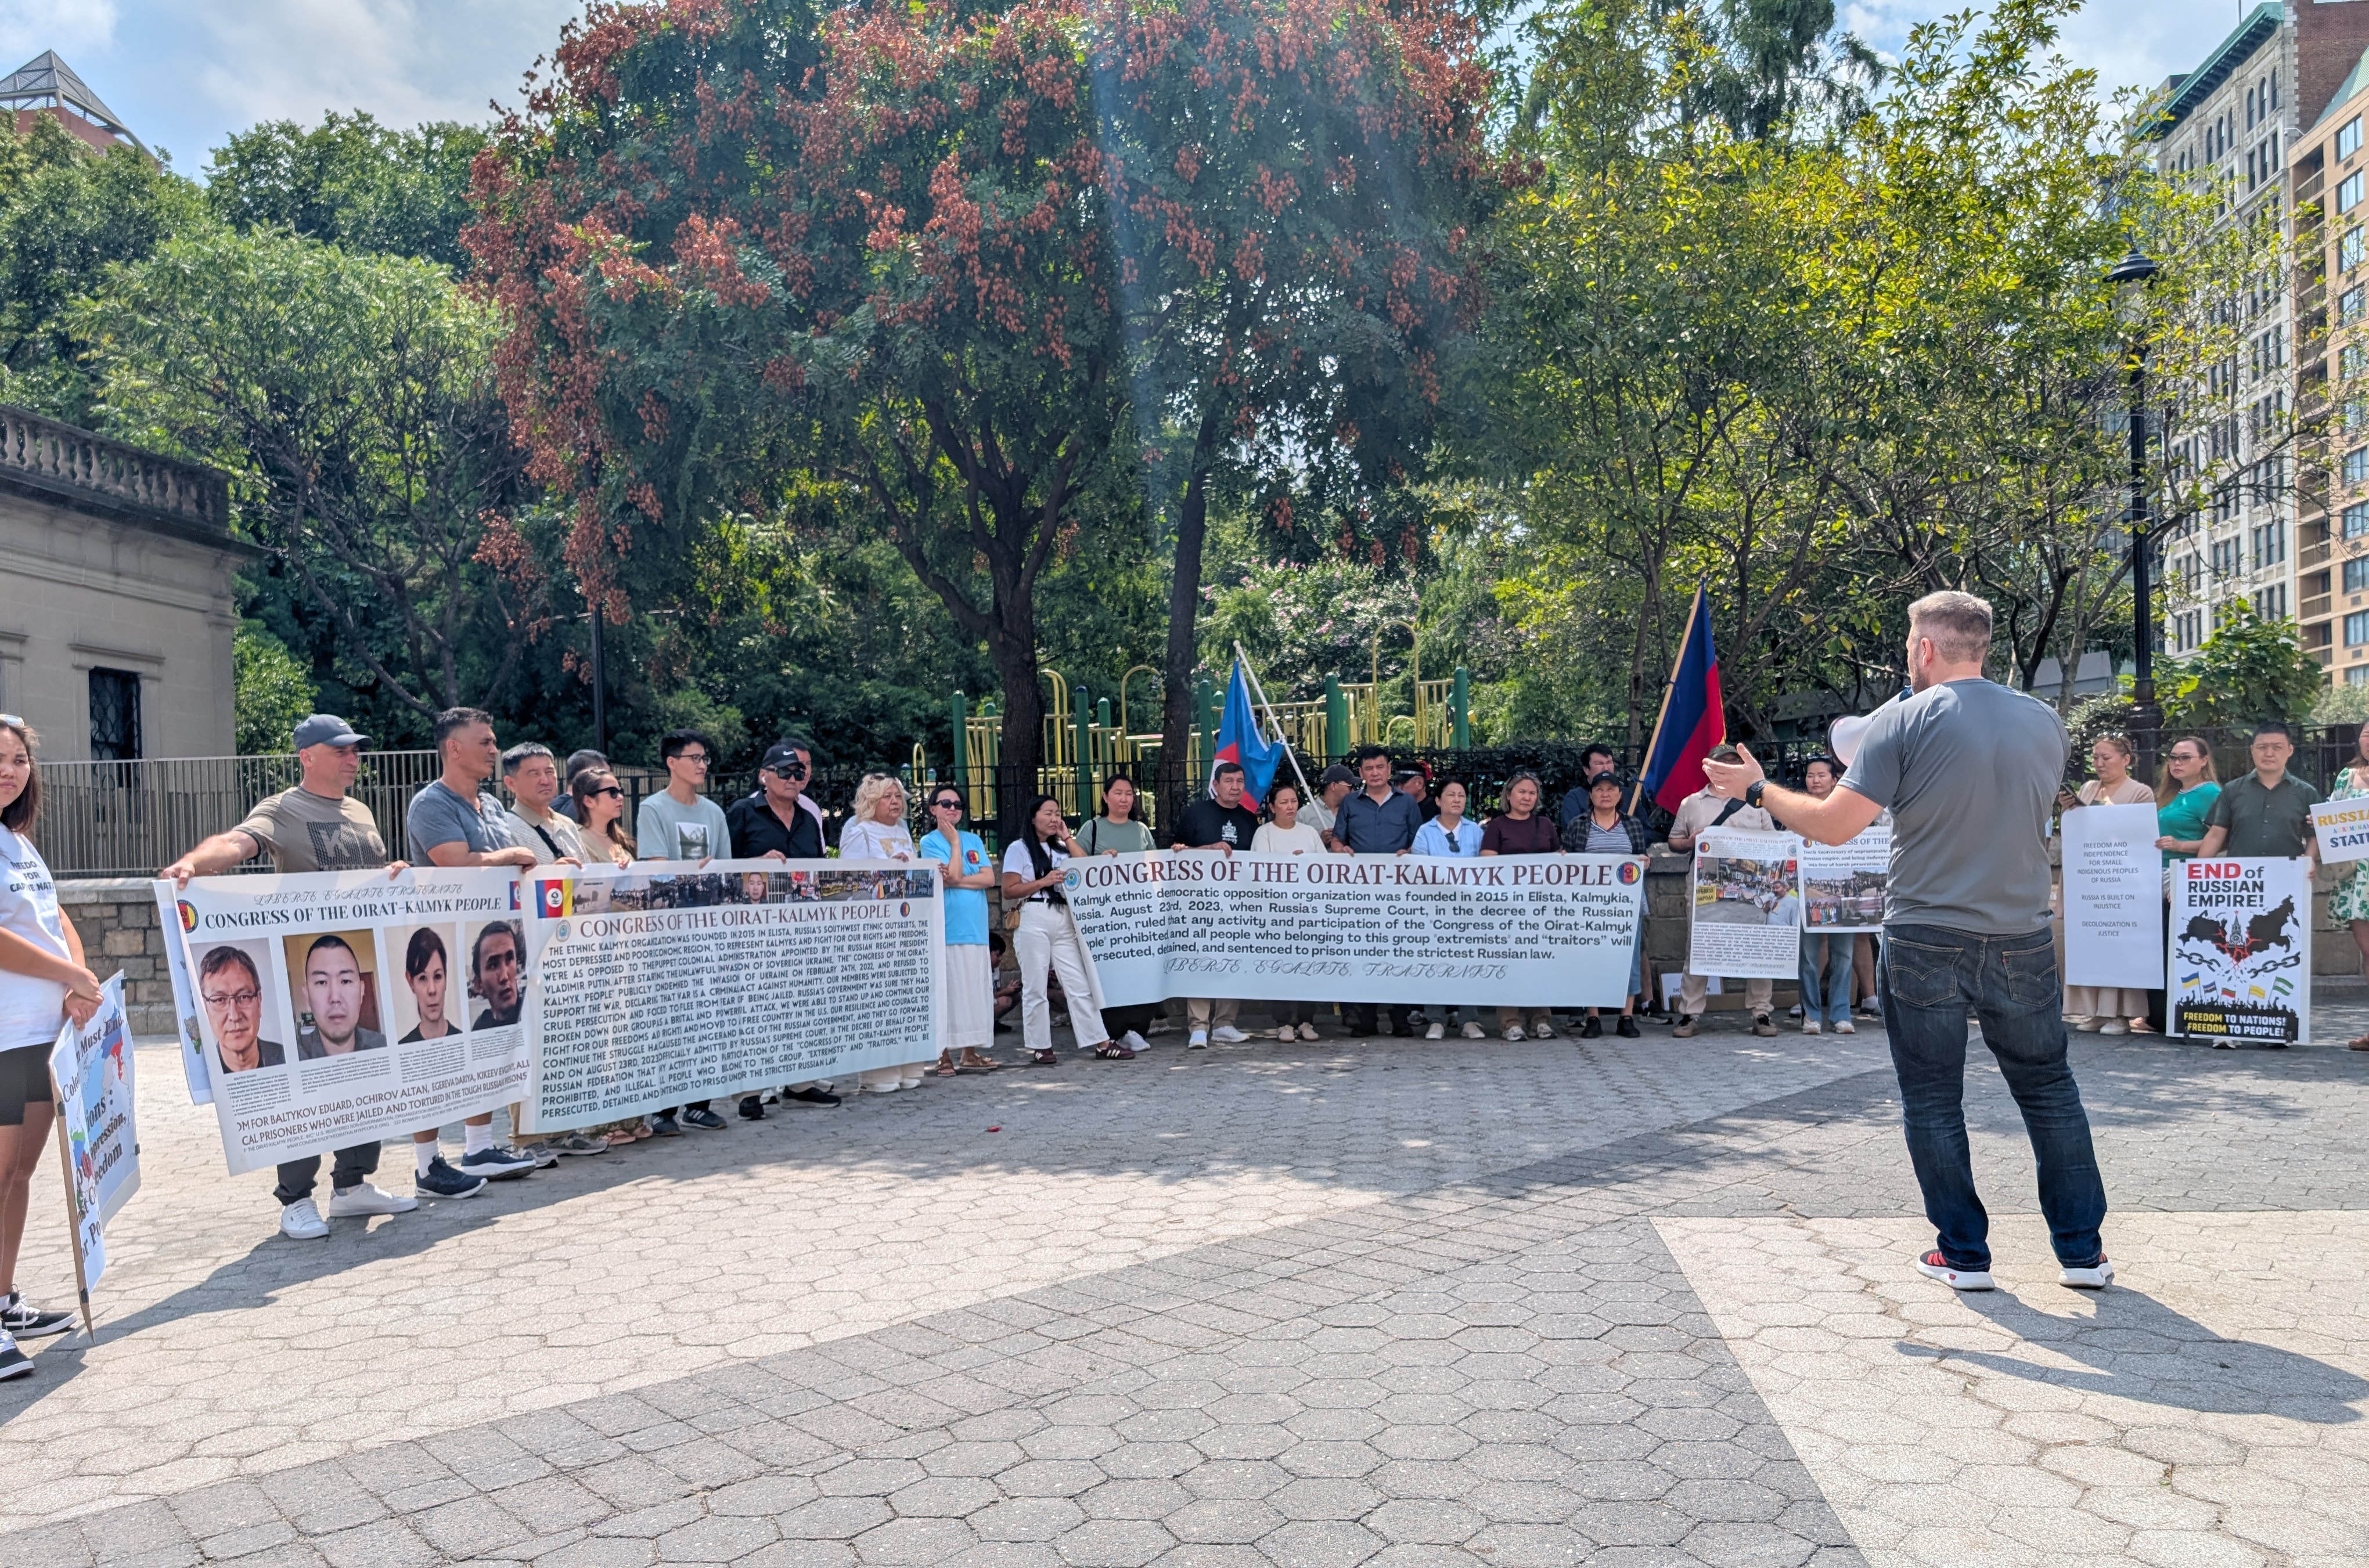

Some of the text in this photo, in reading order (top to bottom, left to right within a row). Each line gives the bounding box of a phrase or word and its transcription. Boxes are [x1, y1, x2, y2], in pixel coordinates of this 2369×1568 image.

[2317, 810, 2369, 827] RUSSI
[1085, 860, 1612, 888] CONGRESS OF THE OIRAT-KALMYK PEOPLE
[2188, 863, 2264, 879] END of
[2188, 880, 2264, 893] RUSSIAN
[1074, 888, 1633, 907] Kalmyk ethnic democratic opposition organization was founded in 2015 in Elista, Kalmykia,
[2188, 895, 2264, 907] EMPIRE!
[205, 897, 501, 929] CONGRESS OF THE OIRAT-KALMYK PEOPLE
[580, 904, 891, 938] CONGRESS OF THE OIRAT-KALMYK PEOPLE
[1081, 921, 1131, 935] deration,
[1135, 916, 1166, 929] ruled
[1168, 914, 1187, 925] that
[1191, 917, 1214, 927] any
[1218, 915, 1266, 928] activity
[1270, 917, 1294, 927] and
[1298, 918, 1380, 931] participation
[1385, 919, 1399, 929] of
[1404, 919, 1425, 929] the
[1499, 920, 1513, 930] of
[1518, 920, 1539, 931] the
[1544, 920, 1632, 935] Oirat-Kalmyk
[549, 946, 563, 957] THE
[567, 943, 596, 954] ETHNIC
[599, 940, 629, 951] KALMYK
[677, 933, 690, 943] WAS
[692, 931, 728, 942] FOUNDED
[730, 931, 737, 939] IN
[739, 929, 755, 939] 2015
[758, 929, 766, 937] IN
[768, 927, 792, 937] ELISTA,
[795, 925, 822, 935] RUSSIA'S
[824, 924, 861, 933] SOUTHWEST
[863, 922, 883, 931] ETHNIC
[919, 920, 928, 928] THE
[1092, 942, 1556, 963] ersecuted, detained, and sentenced to prison under the strictest Russian law.
[2183, 1012, 2287, 1026] FREEDOM TO NATIONS!
[2187, 1022, 2285, 1037] FREEDOM TO PEOPLE!
[81, 1025, 102, 1057] Must
[251, 1117, 269, 1130] FOR
[270, 1106, 318, 1125] BALTYKOV
[319, 1099, 354, 1115] EDUARD,
[355, 1089, 399, 1107] OCHIROV
[400, 1084, 430, 1099] ALTAN,
[431, 1078, 455, 1093] EGEREVA
[477, 1068, 499, 1080] KIKEEV
[542, 1102, 600, 1119] PERSECUTED,
[603, 1094, 641, 1109] DETAINED,
[642, 1090, 660, 1101] AND
[750, 1069, 763, 1078] THE
[765, 1064, 796, 1076] STRICTEST
[798, 1060, 825, 1070] RUSSIAN
[260, 1123, 308, 1142] PRISONERS
[309, 1118, 333, 1130] WHO
[333, 1112, 355, 1126] WERE
[356, 1106, 384, 1122] JAILED
[386, 1102, 408, 1115] AND
[408, 1093, 445, 1108] TORTURED
[451, 1089, 462, 1100] THE
[462, 1084, 482, 1097] TOUGH
